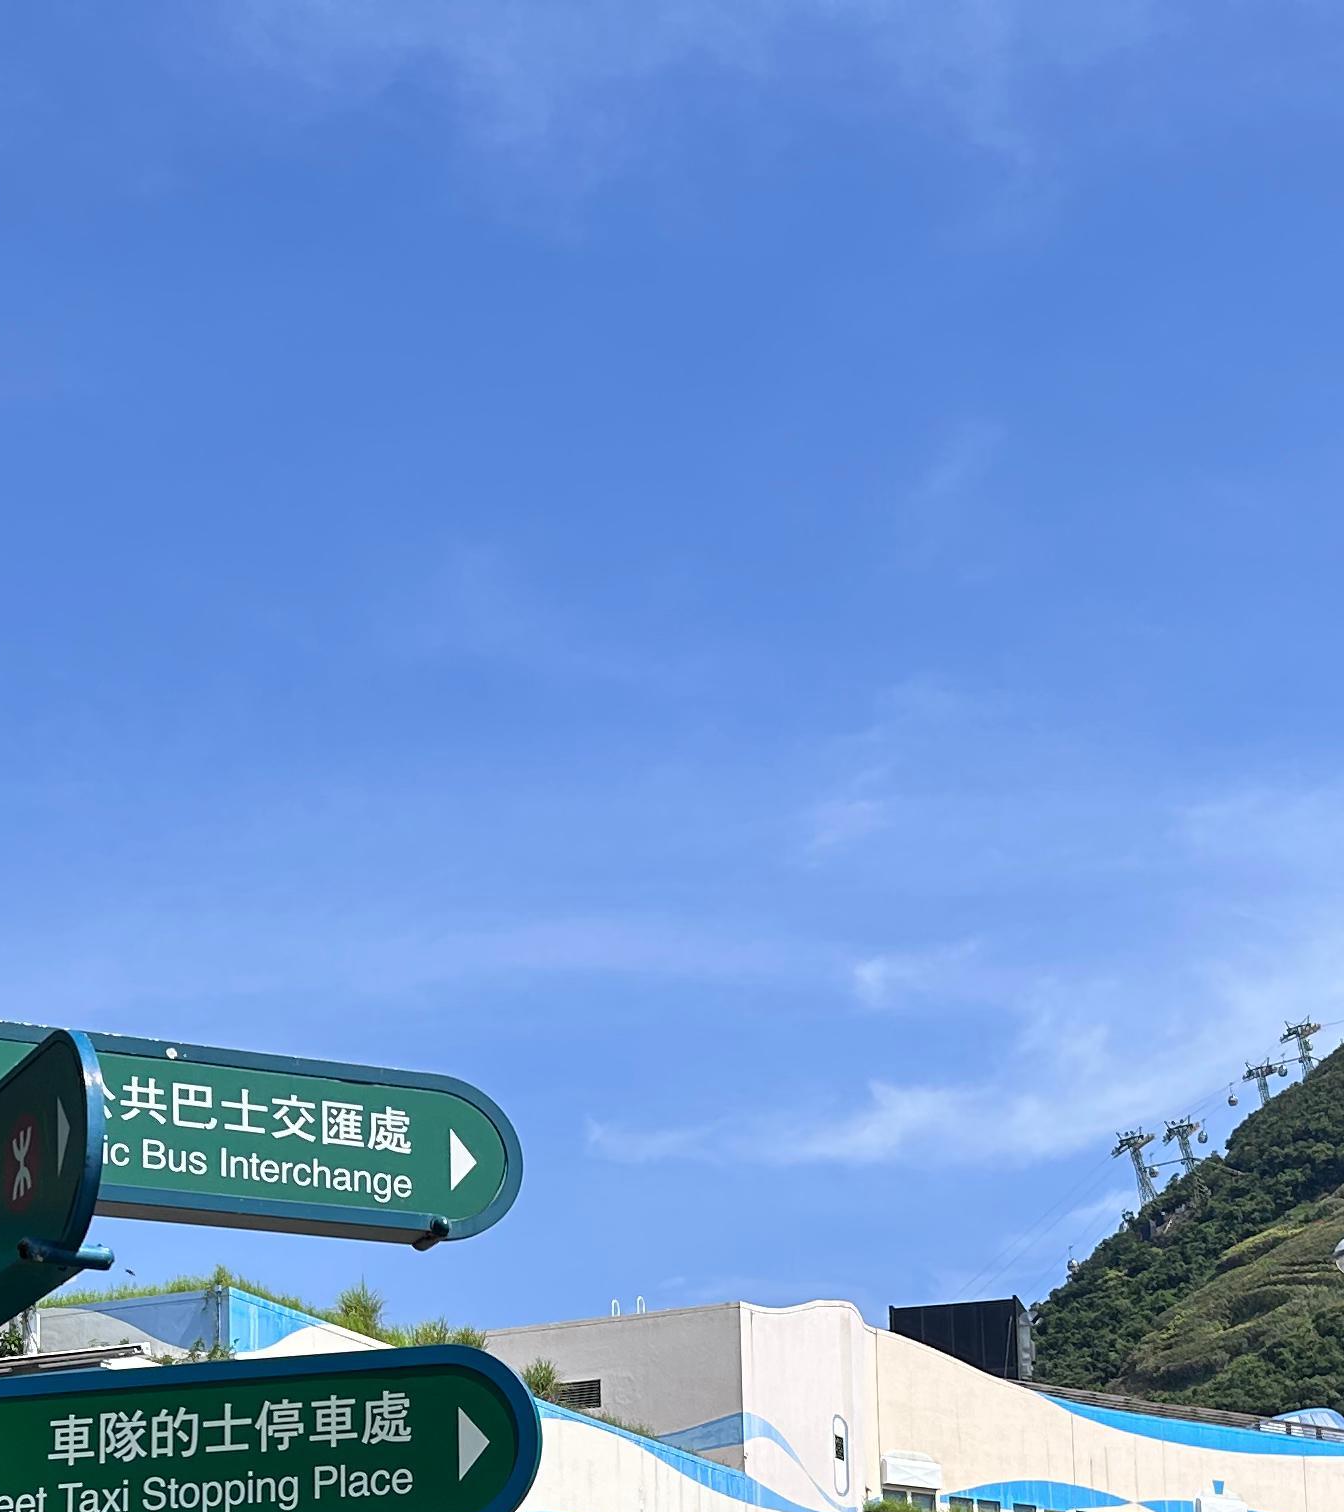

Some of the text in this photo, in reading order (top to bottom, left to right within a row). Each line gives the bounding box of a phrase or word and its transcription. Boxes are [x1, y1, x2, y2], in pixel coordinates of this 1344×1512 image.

[142, 1138, 207, 1175] Bus
[220, 1147, 413, 1204] Interchange
[48, 1390, 412, 1466] 車隊的士停車處
[314, 1464, 413, 1500] Place
